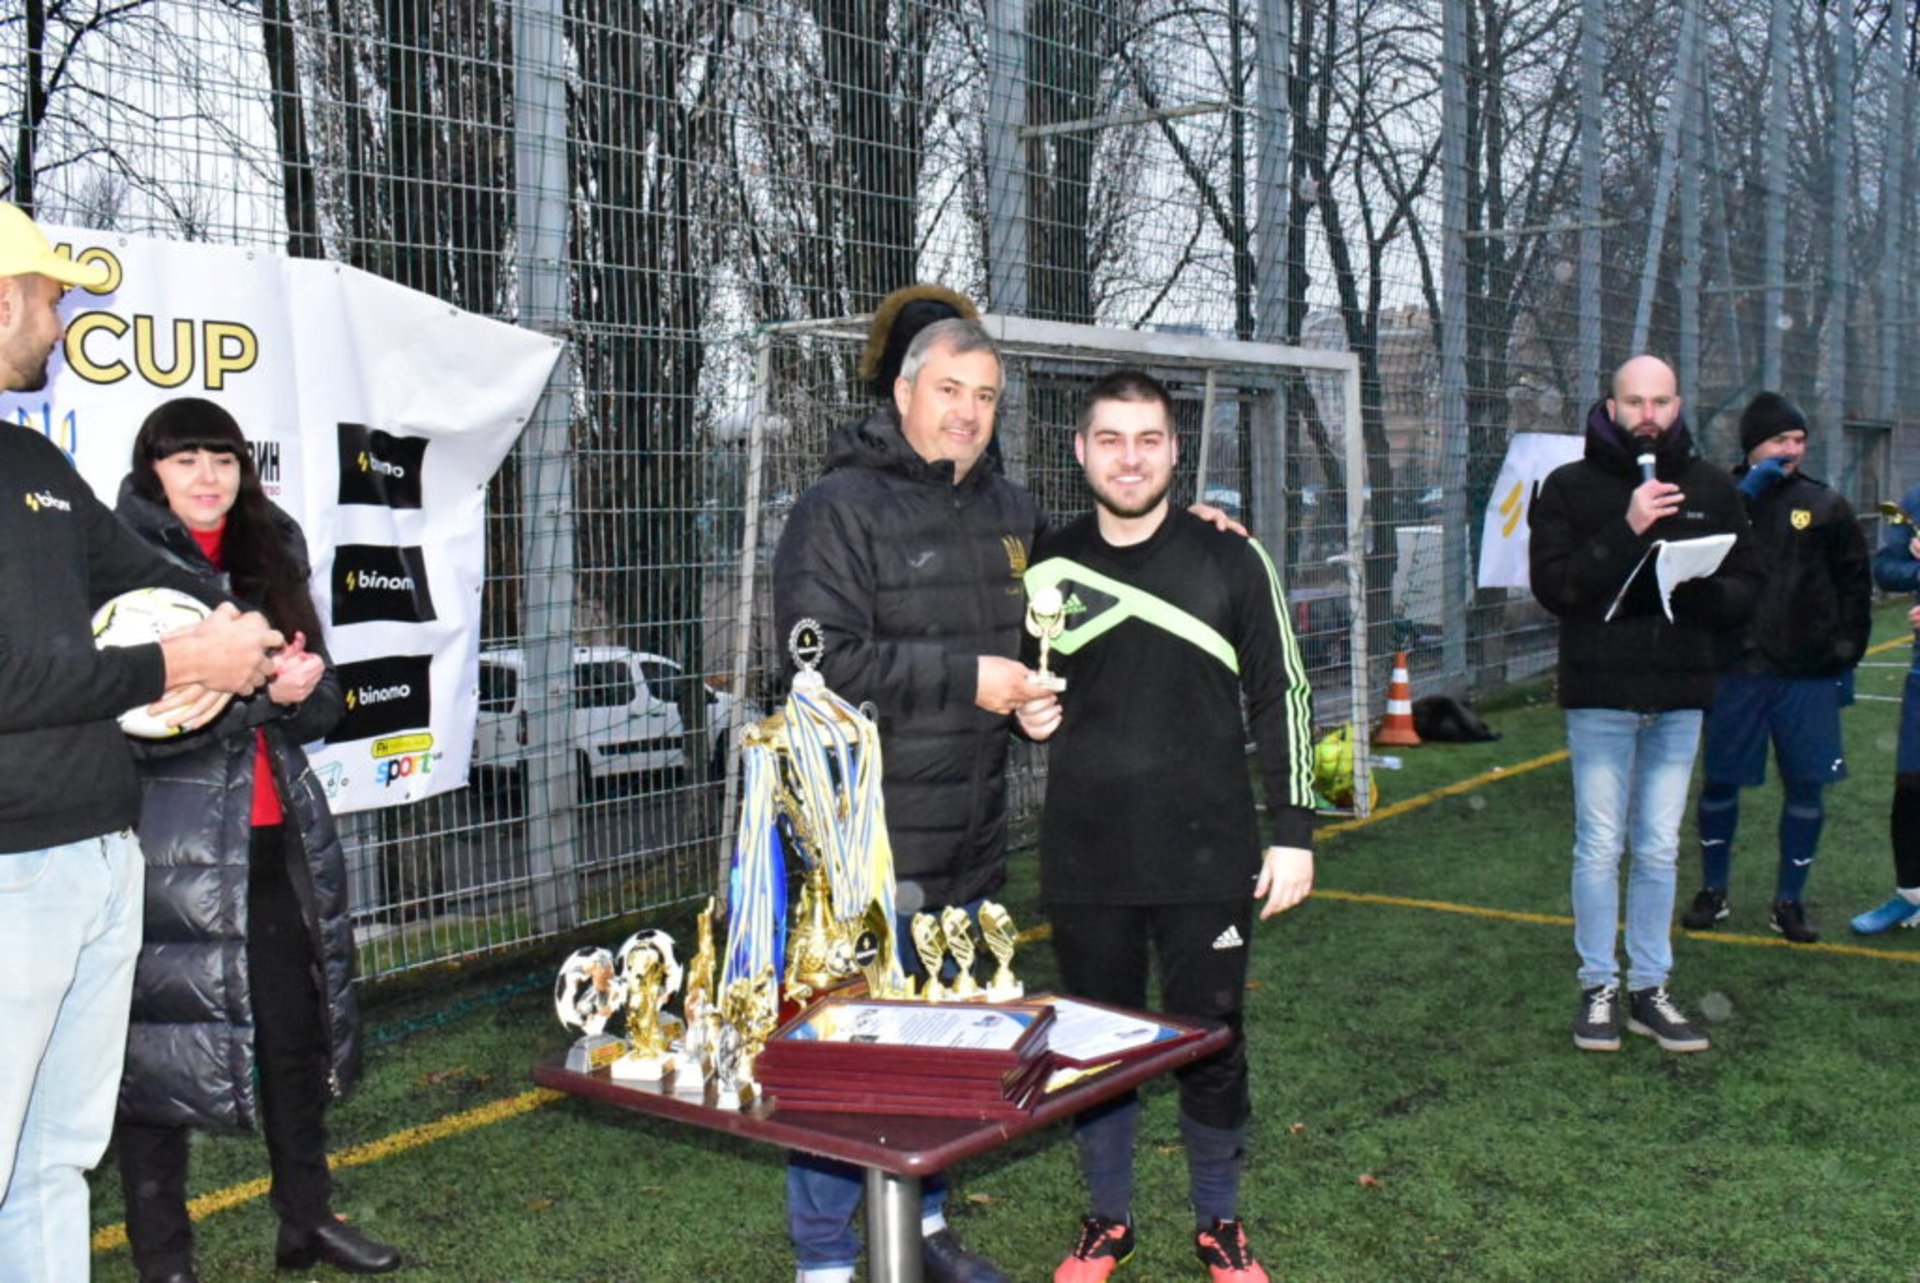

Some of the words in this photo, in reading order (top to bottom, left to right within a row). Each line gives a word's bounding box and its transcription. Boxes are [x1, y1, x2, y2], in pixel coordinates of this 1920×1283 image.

[63, 310, 259, 391] CUP
[358, 683, 411, 705] binomo
[375, 751, 433, 788] sport
